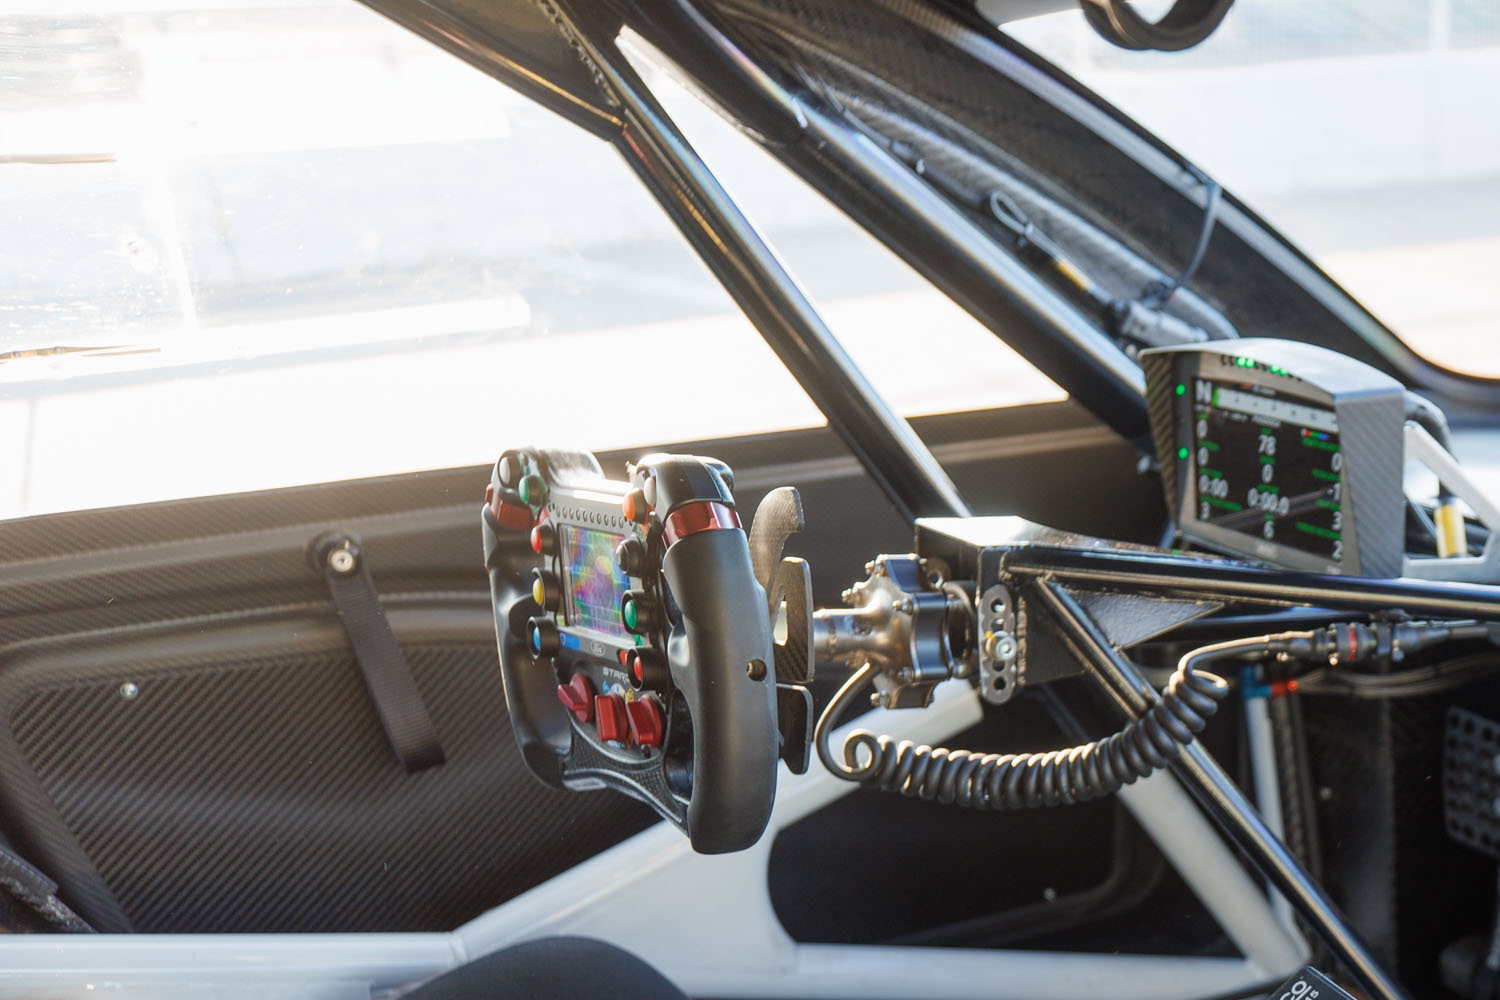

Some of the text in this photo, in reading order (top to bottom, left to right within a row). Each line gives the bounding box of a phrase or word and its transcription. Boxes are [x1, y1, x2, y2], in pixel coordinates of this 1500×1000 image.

[1258, 434, 1276, 456] 78
[1262, 463, 1273, 484] 0
[1199, 474, 1229, 499] 0:00
[1247, 487, 1290, 516] 0:00.0
[1331, 540, 1342, 559] 2
[603, 666, 629, 685] STAR
